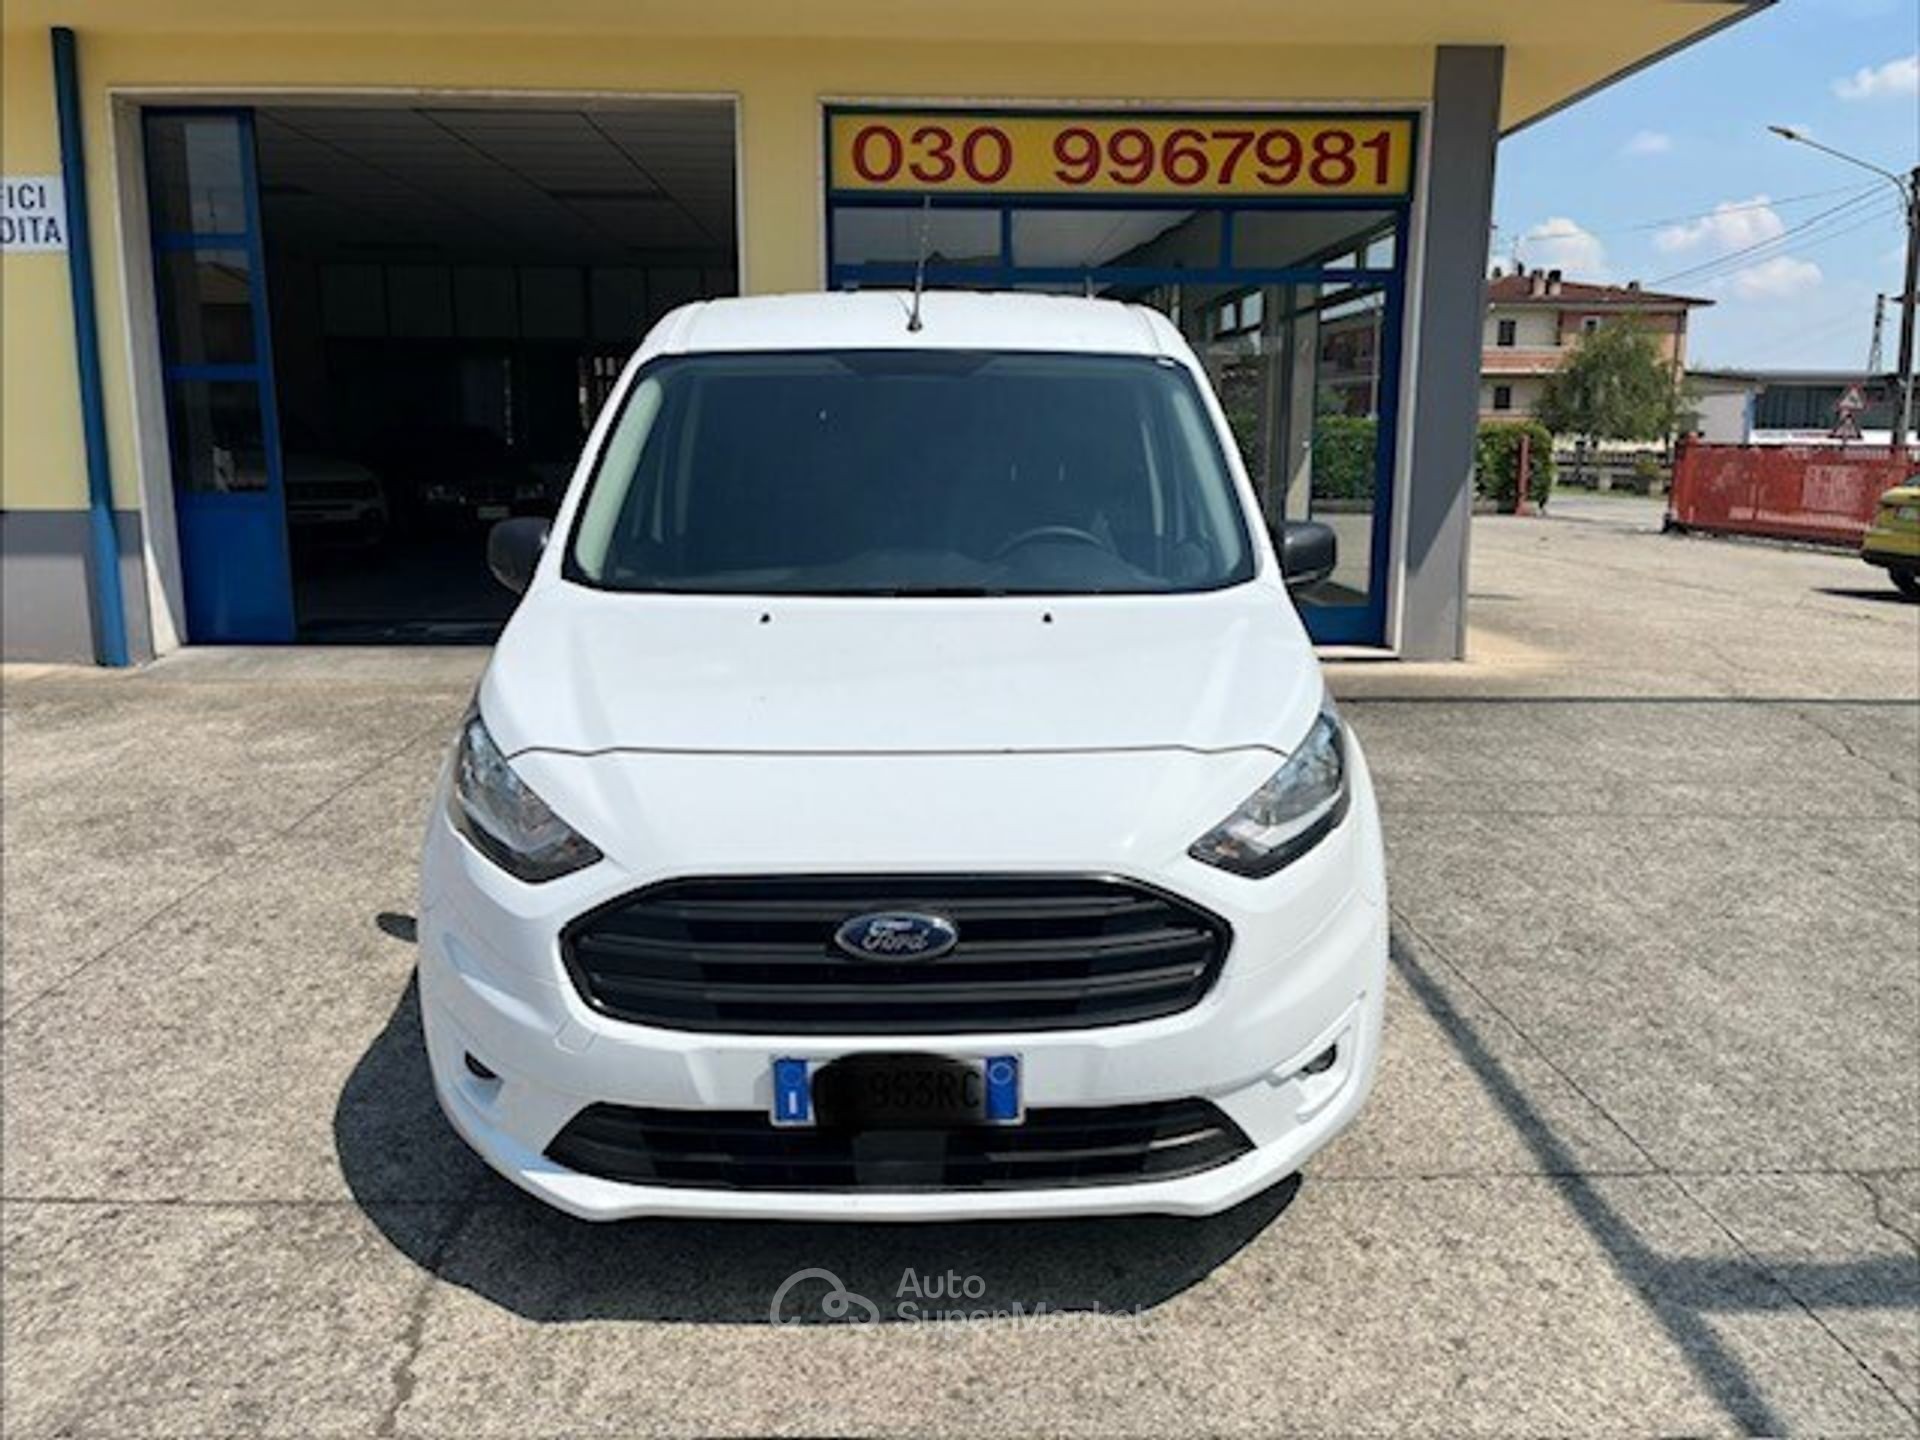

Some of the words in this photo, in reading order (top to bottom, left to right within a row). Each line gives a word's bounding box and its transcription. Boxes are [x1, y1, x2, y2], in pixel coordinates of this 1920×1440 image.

[851, 126, 1013, 183] 030
[1053, 128, 1392, 185] 9967981
[0, 183, 46, 209] ICI
[861, 920, 929, 950] Ford
